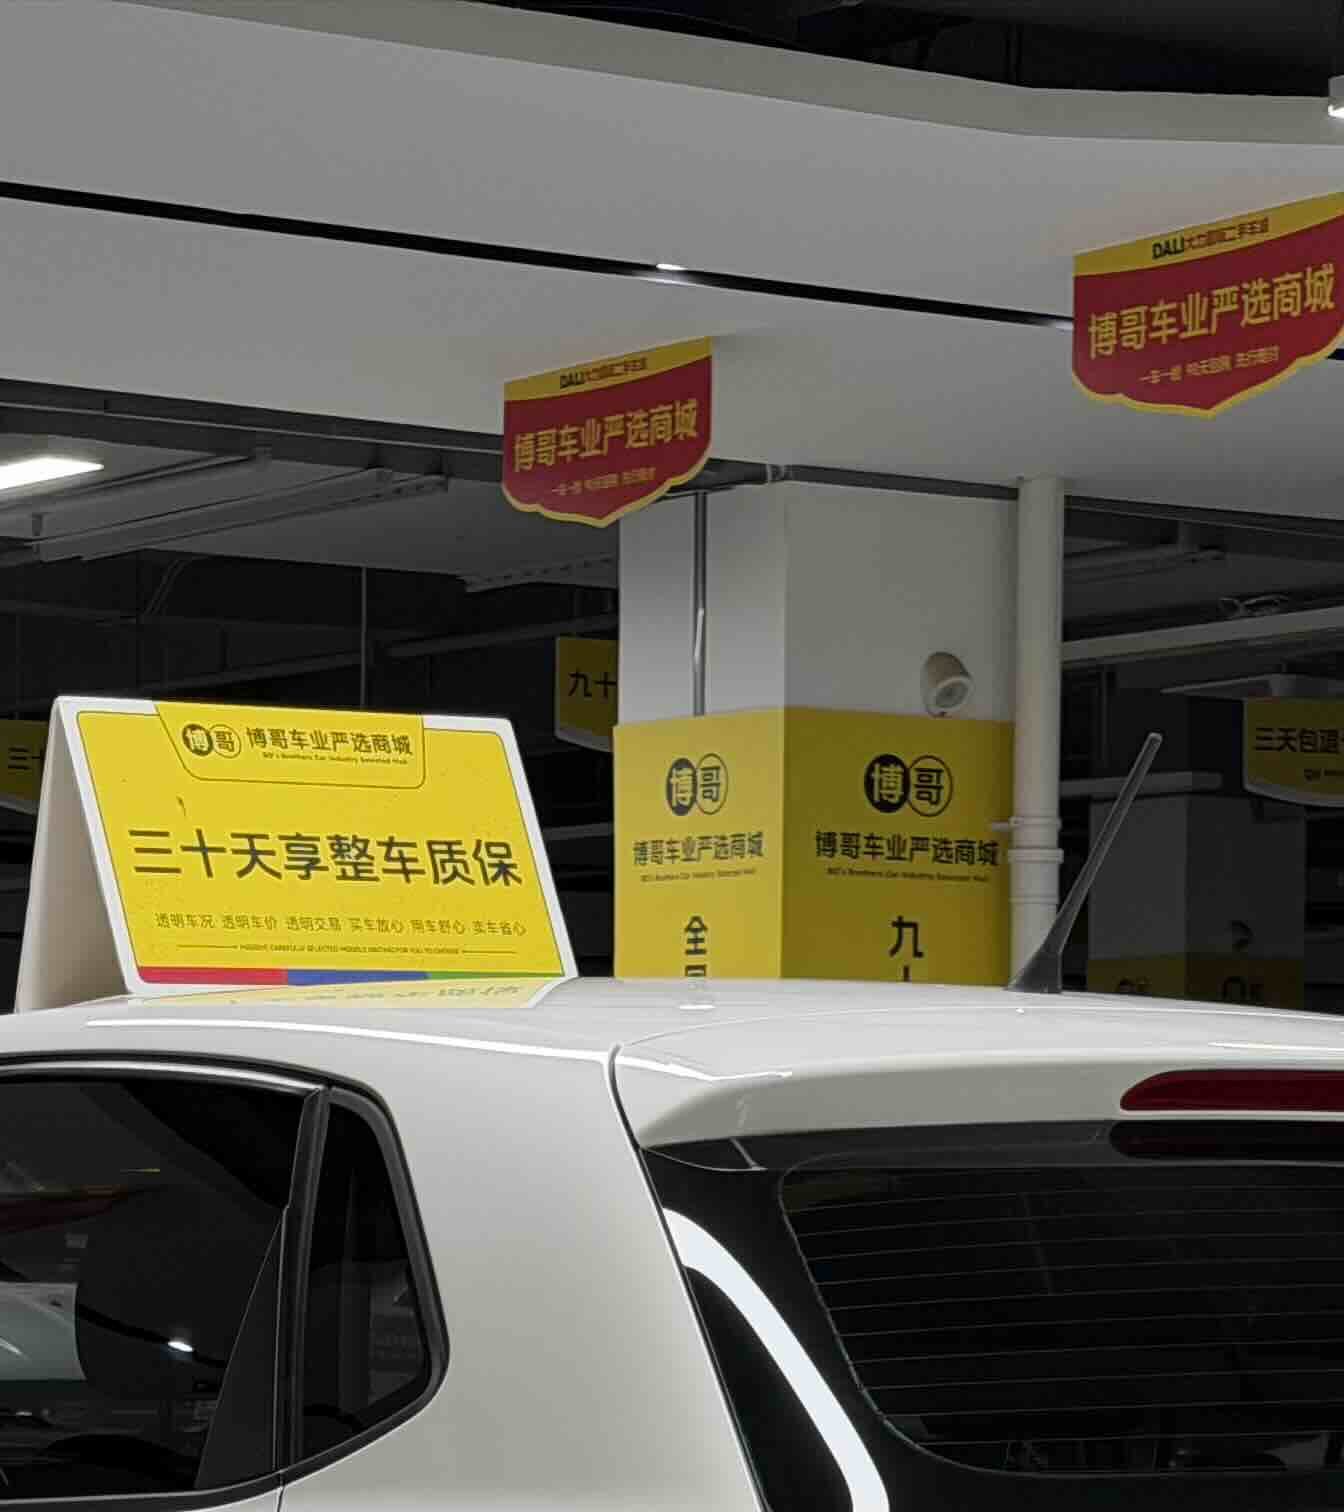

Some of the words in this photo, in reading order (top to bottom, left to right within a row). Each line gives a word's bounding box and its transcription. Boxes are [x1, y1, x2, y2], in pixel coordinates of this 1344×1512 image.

[1087, 263, 1336, 360] 博哥车业严选商城
[514, 398, 699, 473] 博哥车业严选商城
[246, 728, 413, 756] 博哥车业严选商城
[669, 758, 724, 811] 博哥
[868, 758, 948, 811] 博哥
[128, 828, 523, 888] 三十天享整车质保
[632, 832, 764, 865] 博哥车业严选商城
[815, 832, 1000, 865] 博哥车业严选商城
[155, 912, 216, 930] 透明车况
[221, 914, 278, 932] 透明车价
[285, 915, 342, 933] 透明交易
